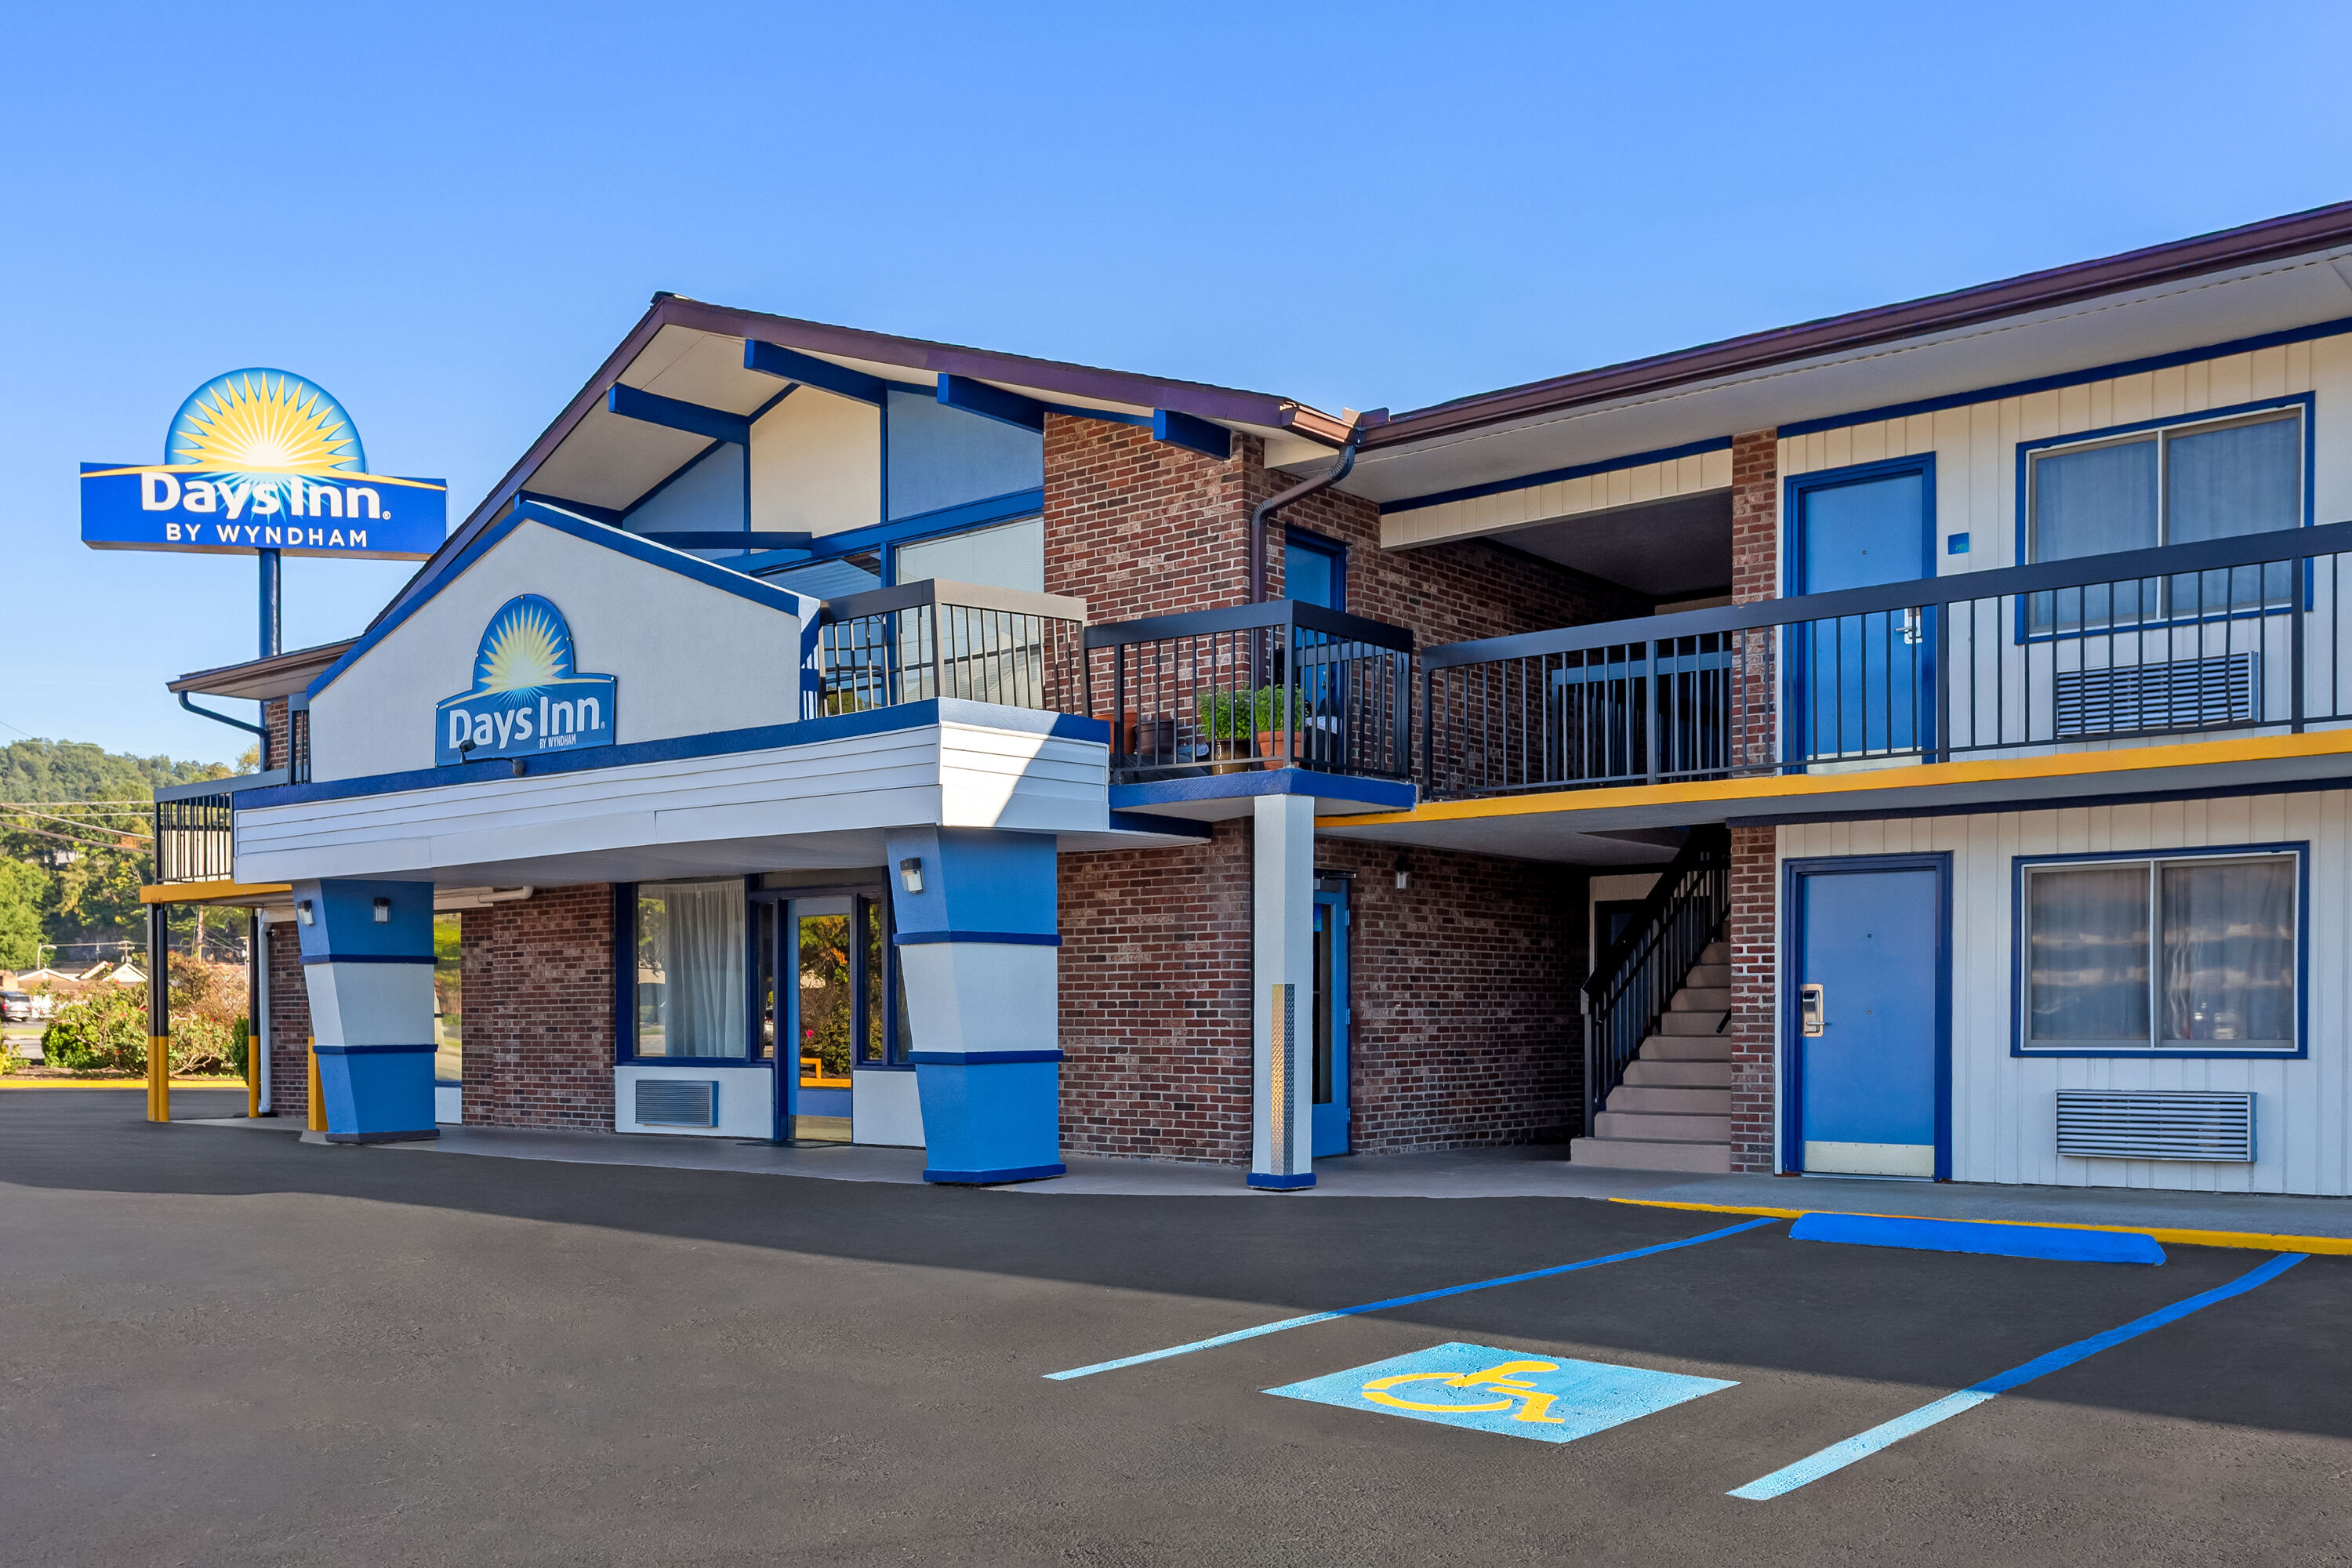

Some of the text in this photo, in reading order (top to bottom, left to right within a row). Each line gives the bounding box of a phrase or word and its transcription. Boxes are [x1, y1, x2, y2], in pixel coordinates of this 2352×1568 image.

[141, 471, 280, 519] Days
[166, 523, 367, 547] BY WYNDHAM
[449, 707, 533, 750] Days
[539, 733, 576, 750] BY WYNDHAM
